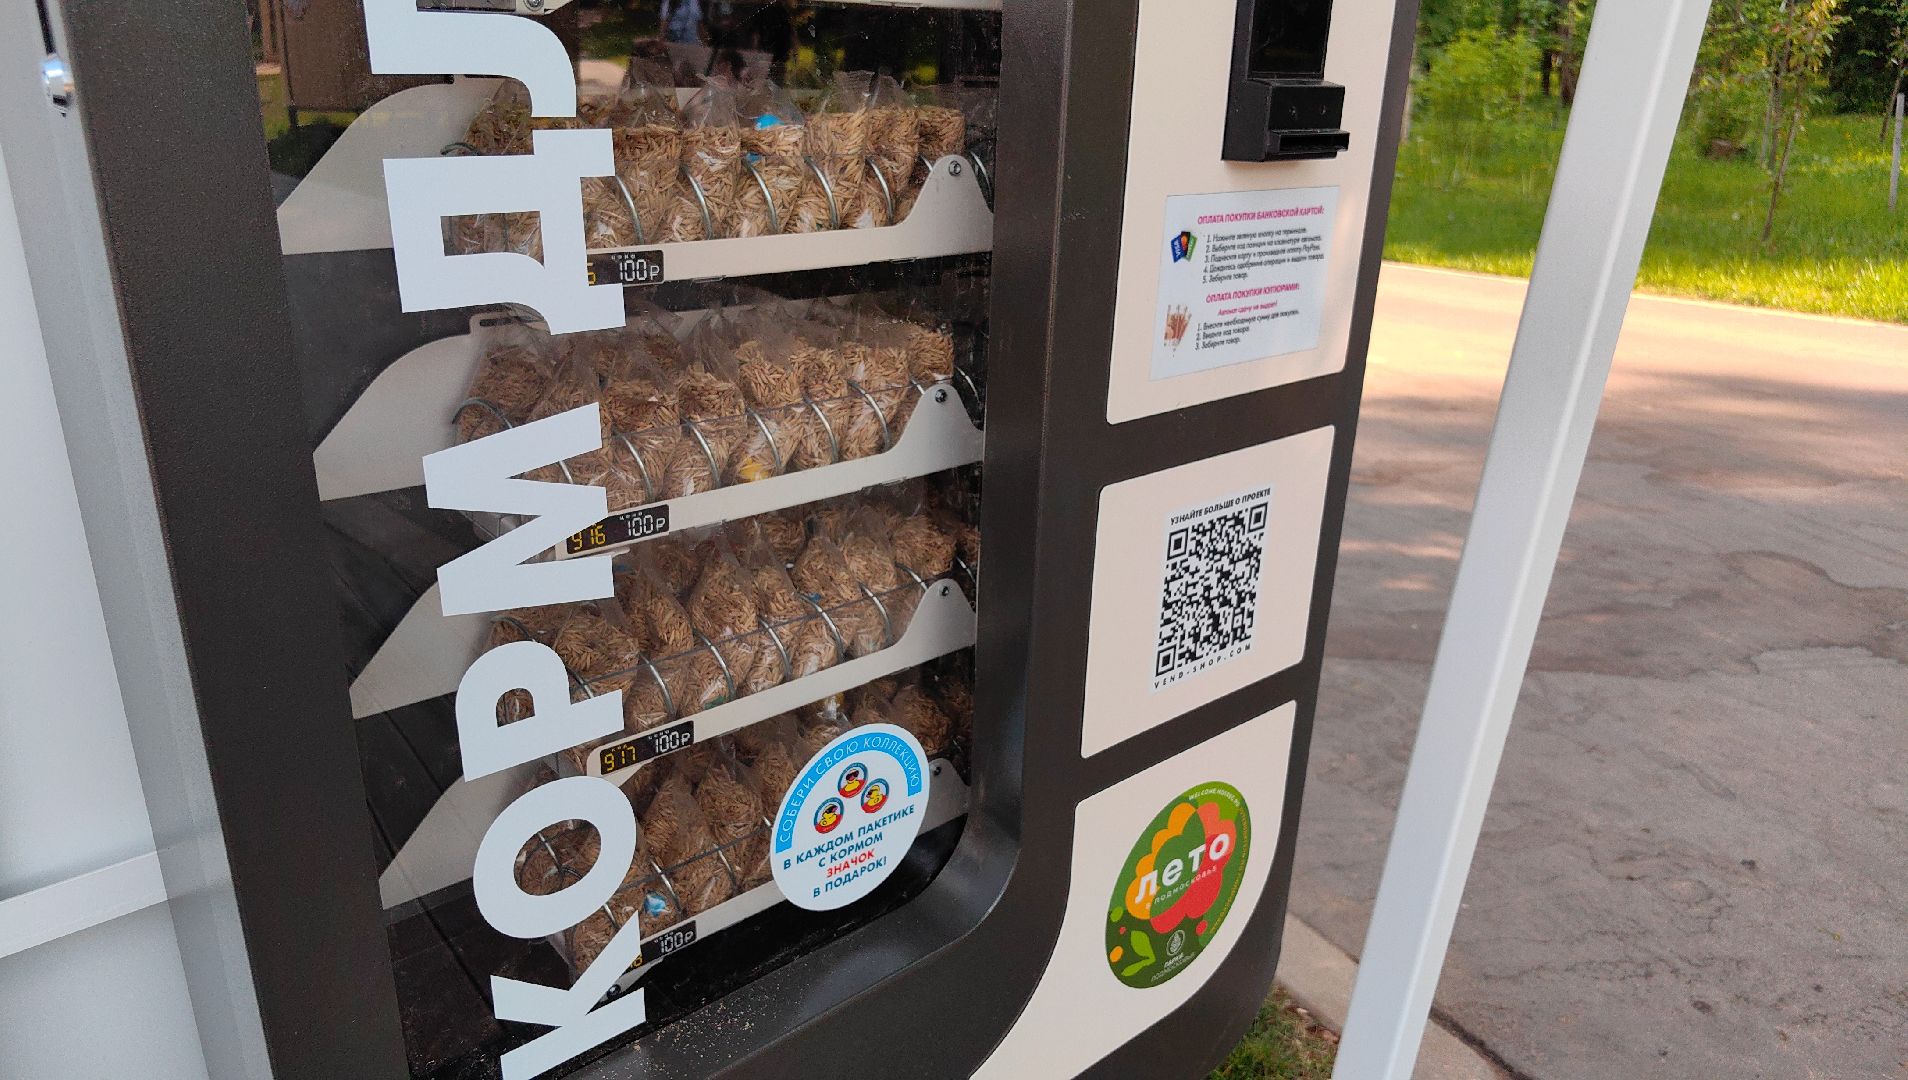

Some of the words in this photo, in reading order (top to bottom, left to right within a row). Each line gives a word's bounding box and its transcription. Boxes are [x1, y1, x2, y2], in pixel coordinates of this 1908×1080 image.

[1198, 214, 1223, 224] ОПЛАТА
[1225, 212, 1256, 222] ПОКУПКИ
[1257, 207, 1299, 220] БАНКОВСКОЙ
[1205, 292, 1232, 303] ОПЛАТА
[1232, 287, 1262, 299] ПОКУПКИ
[1171, 509, 1203, 525] УЗНАЙТЕ
[1204, 498, 1234, 515] БОЛЬШЕ
[1235, 497, 1241, 505] О
[1241, 488, 1271, 503] ПРОЕКТЕ
[1154, 643, 1251, 689] VEND-SHOP.COM
[423, 402, 646, 1080] КОРМ
[604, 745, 636, 772] 917
[780, 777, 815, 842] СОБЕРИ
[816, 741, 859, 775] СВОЮ
[864, 736, 920, 787] КОЛЛЕКЦИЮ
[783, 858, 792, 870] В
[796, 832, 854, 865] КАЖДОМ
[858, 804, 915, 838] ПАКЕТИКЕ
[818, 857, 826, 868] С
[830, 832, 883, 864] КОРМОМ
[813, 887, 821, 898] В
[825, 856, 887, 892] ПОДАРОК!
[826, 848, 876, 878] ЗНАЧОК
